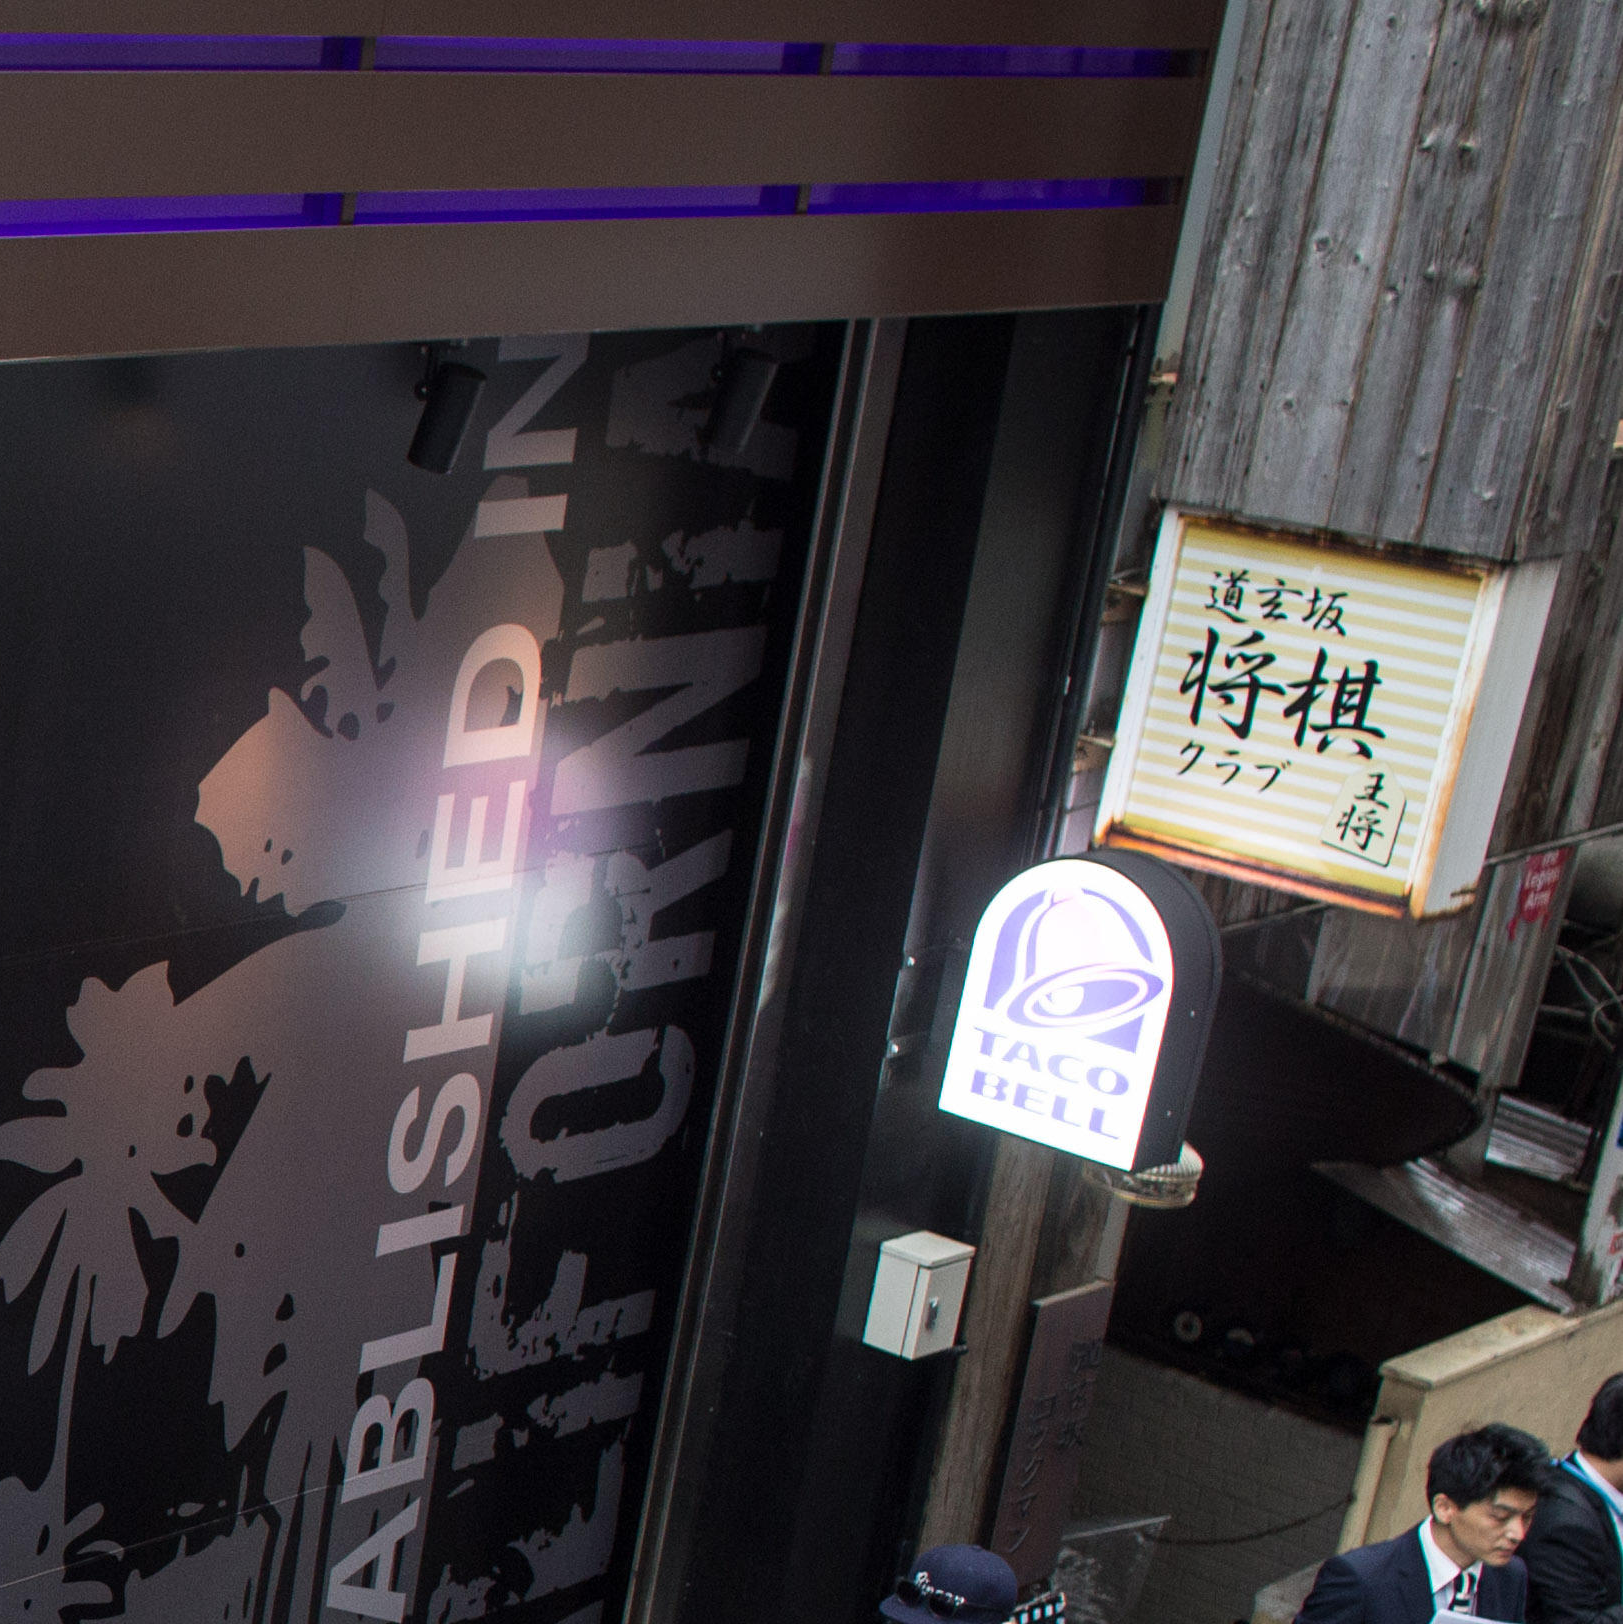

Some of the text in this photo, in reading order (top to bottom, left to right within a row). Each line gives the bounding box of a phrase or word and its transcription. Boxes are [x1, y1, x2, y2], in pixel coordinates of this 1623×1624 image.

[472, 331, 591, 540] IN
[1204, 569, 1350, 637] 道玄坂
[1179, 626, 1385, 760] 将棋
[1175, 740, 1292, 794] クラブ
[1335, 772, 1390, 852] 王将
[971, 1027, 1130, 1099] TACO
[968, 1069, 1122, 1141] BELL
